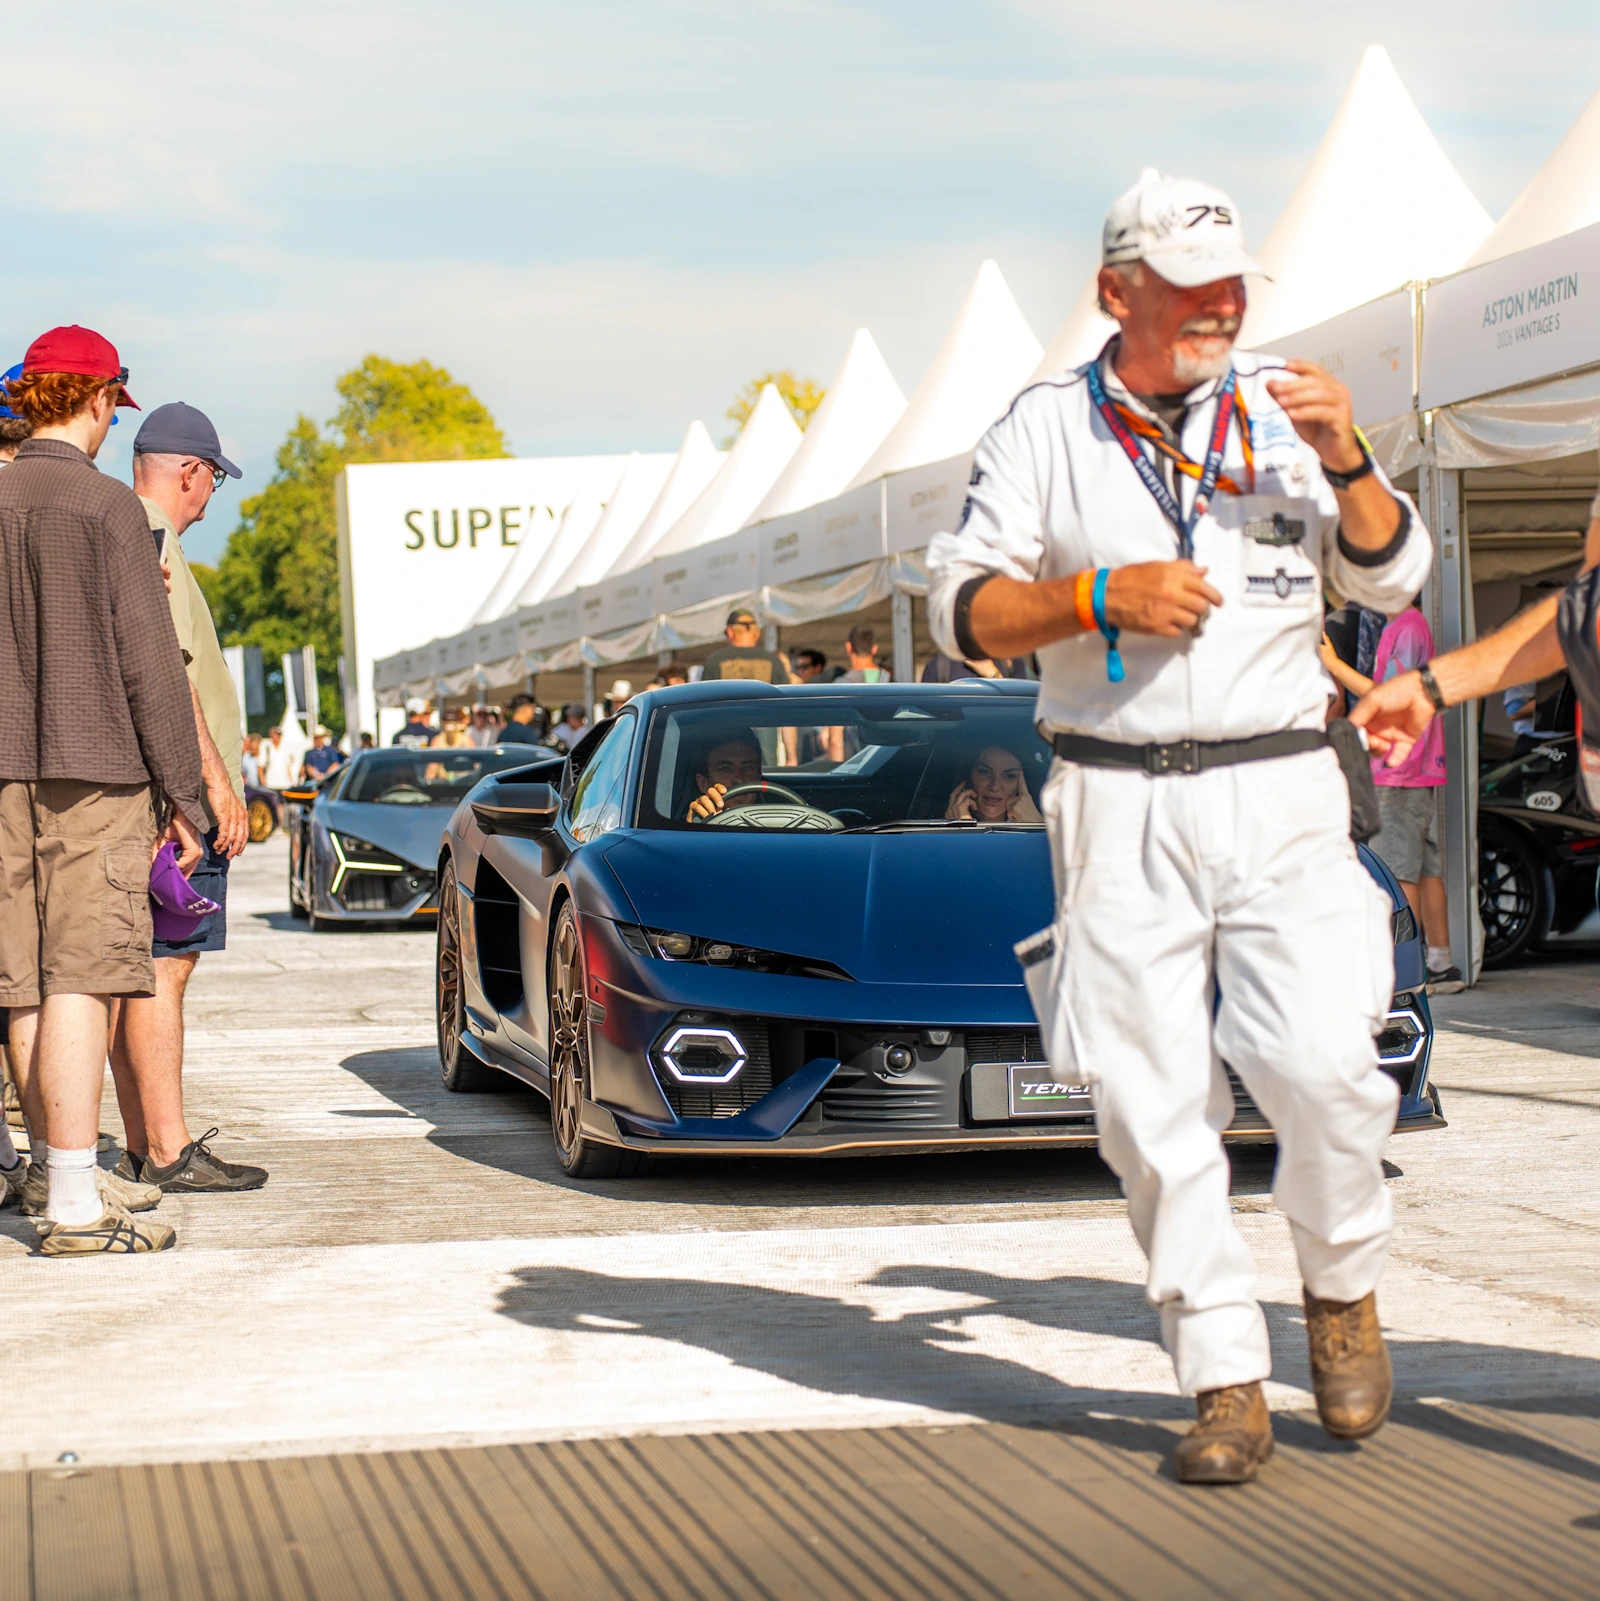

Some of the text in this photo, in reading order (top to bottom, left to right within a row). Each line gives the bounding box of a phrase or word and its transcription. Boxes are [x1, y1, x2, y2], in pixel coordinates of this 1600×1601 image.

[1482, 272, 1578, 329] ASTON MARTIN
[1515, 315, 1554, 343] VANTAGE
[1555, 312, 1561, 331] S
[403, 502, 606, 550] SUPE
[1534, 796, 1554, 806] 605
